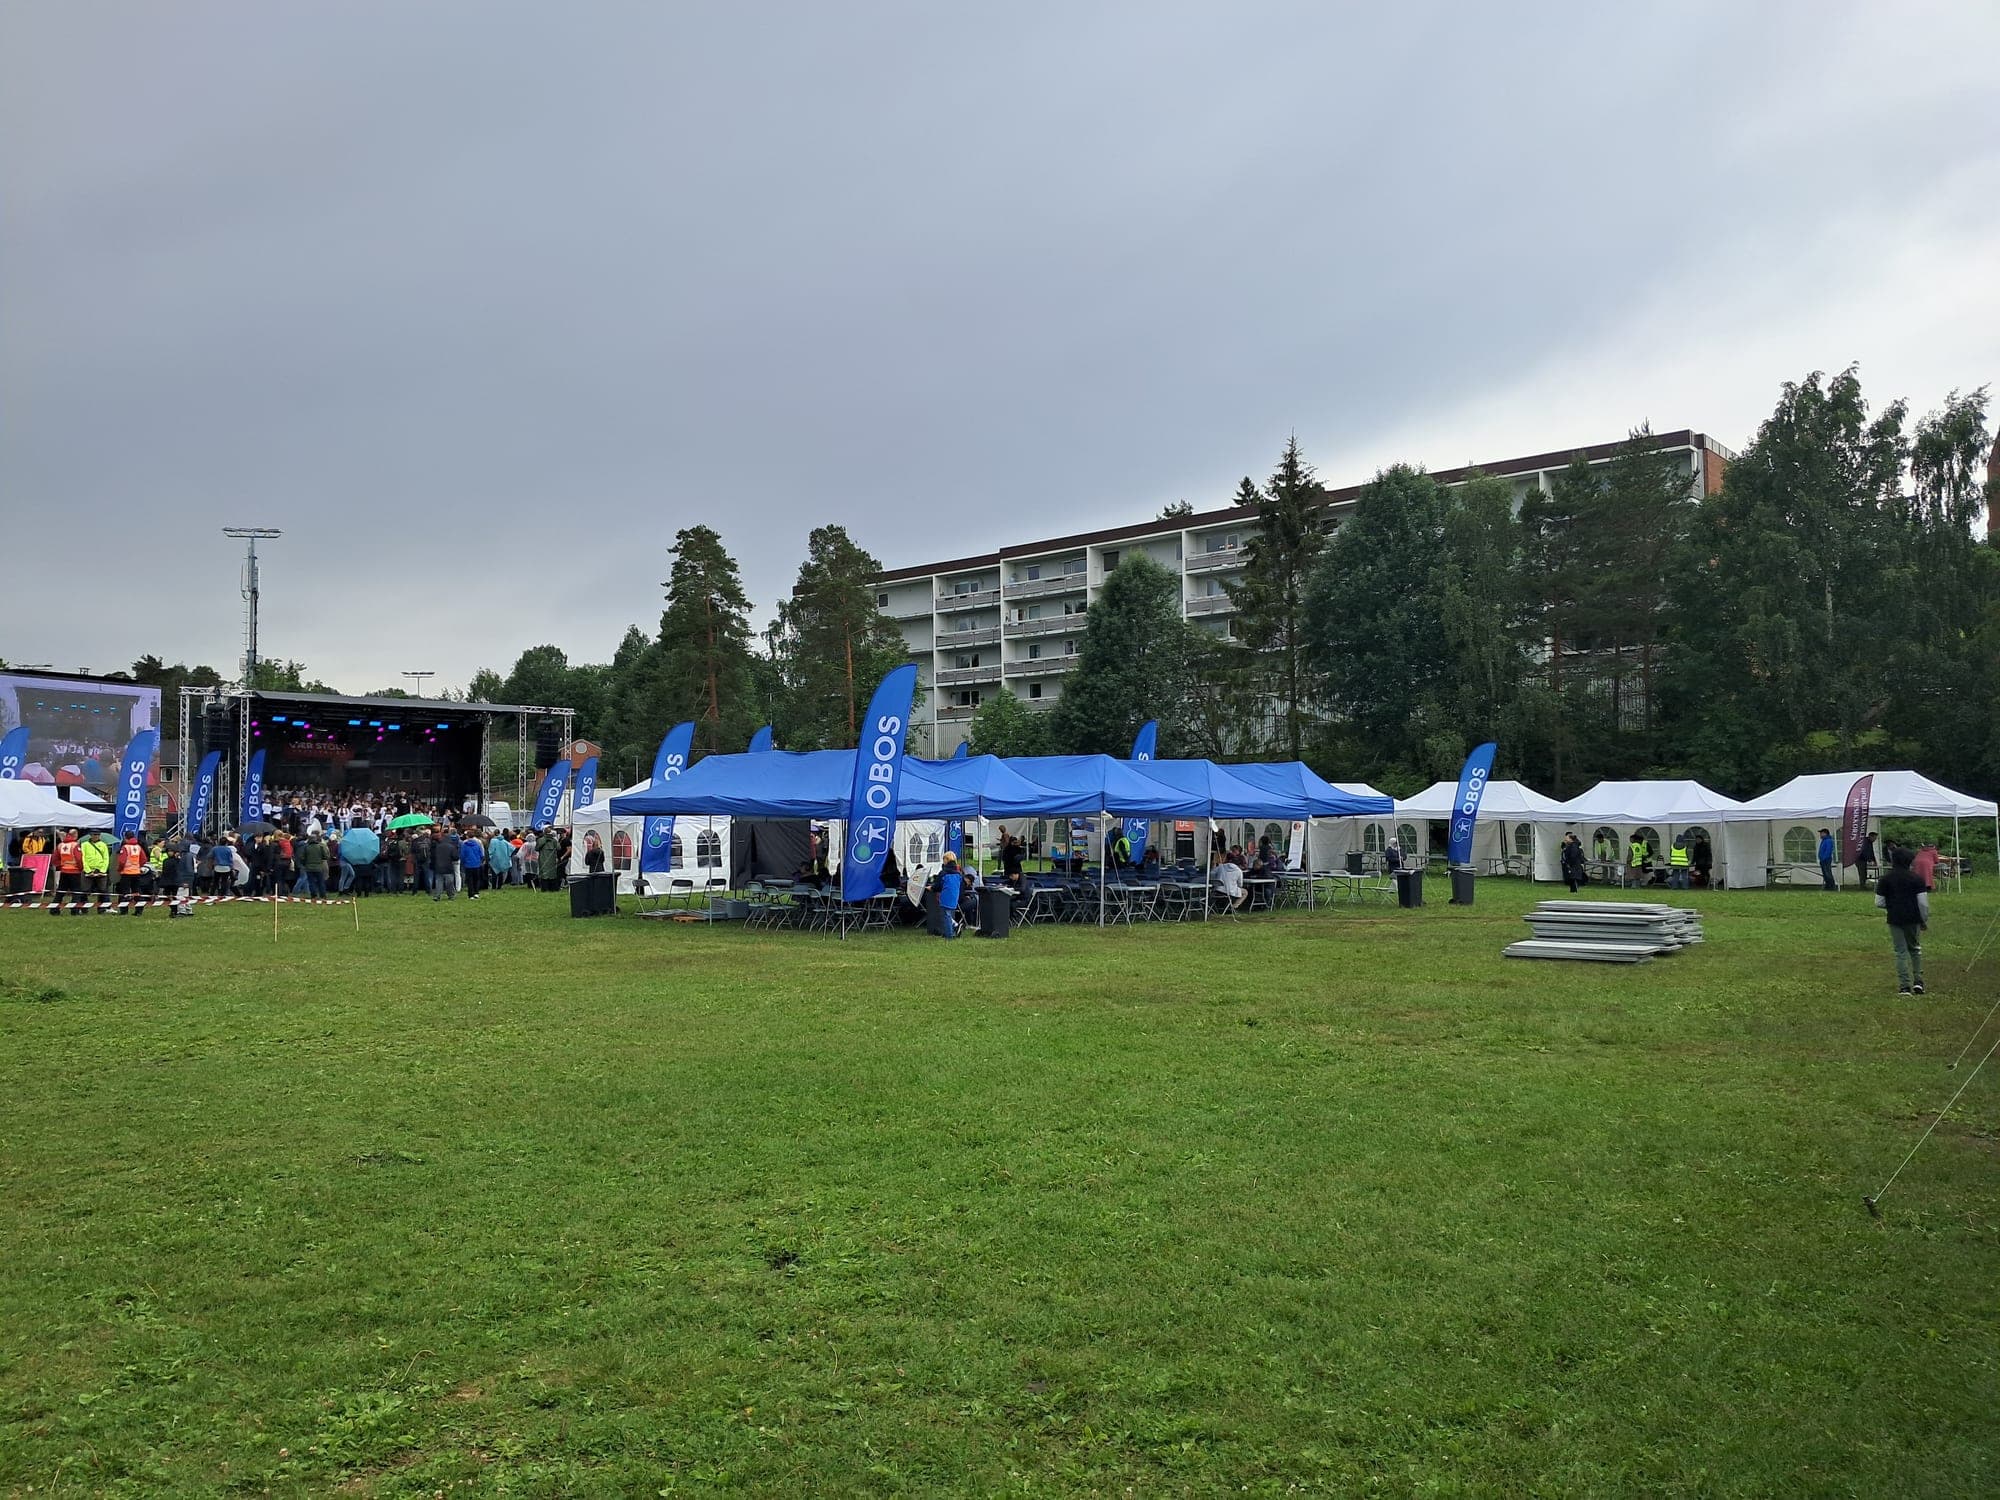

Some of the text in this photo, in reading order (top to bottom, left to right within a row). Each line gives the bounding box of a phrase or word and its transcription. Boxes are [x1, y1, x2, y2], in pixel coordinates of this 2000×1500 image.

[1, 756, 18, 779] OS
[664, 753, 684, 781] OS
[866, 716, 900, 809] OBOS
[125, 761, 145, 819] OBOS
[196, 774, 212, 820] OBOS
[248, 773, 260, 818] OBOS
[542, 778, 563, 817] OBOS
[580, 776, 593, 809] BOS
[1462, 767, 1486, 815] OBOS
